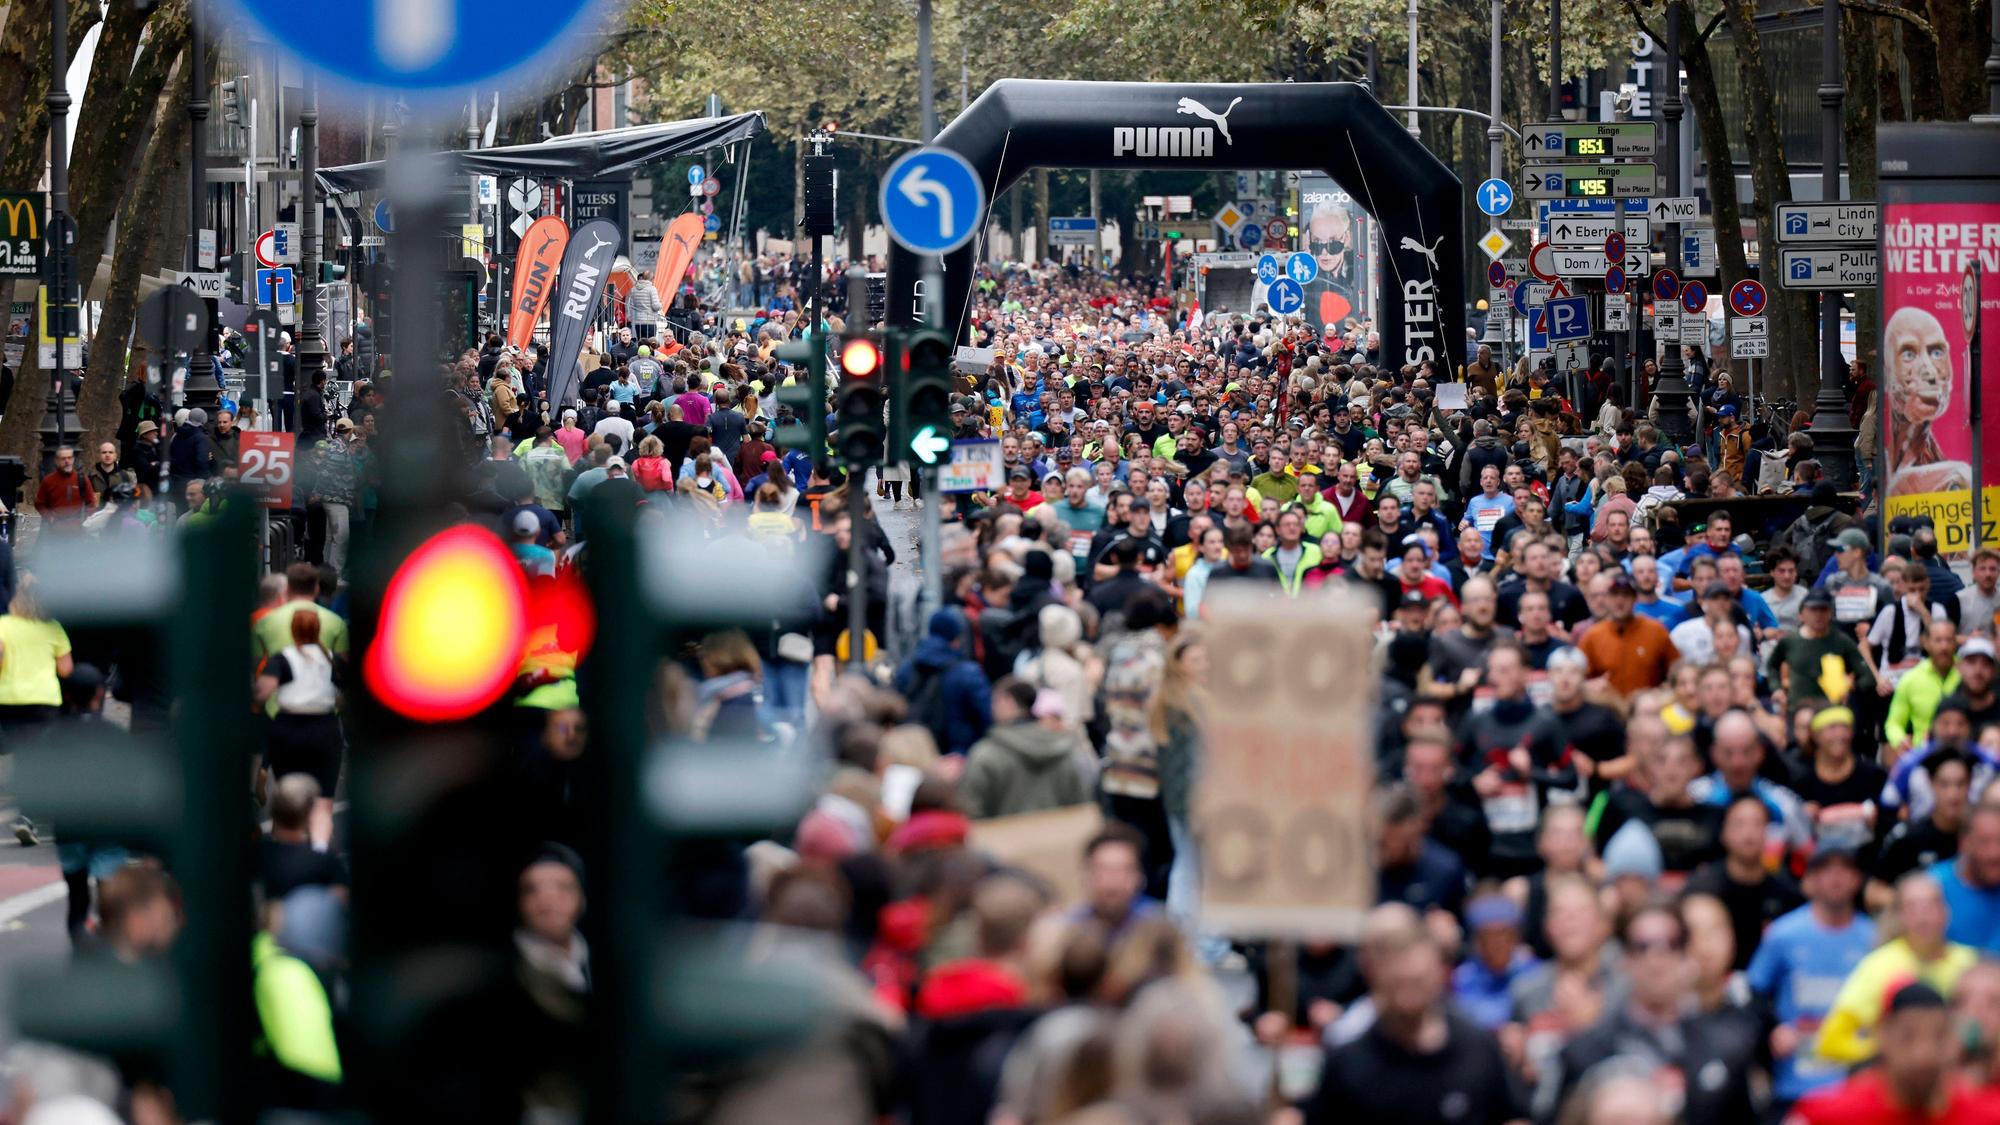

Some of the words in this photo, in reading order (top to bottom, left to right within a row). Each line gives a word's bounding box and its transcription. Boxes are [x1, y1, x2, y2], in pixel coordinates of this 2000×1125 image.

[1597, 126, 1620, 136] Ringe
[1113, 127, 1214, 157] PUMA
[1578, 139, 1605, 154] 851
[1597, 167, 1620, 177] Ringe
[1579, 179, 1606, 195] 495
[576, 193, 616, 205] WIESS
[1303, 191, 1350, 203] zalando
[577, 206, 601, 217] MIT
[1674, 203, 1694, 216] WC
[1271, 223, 1284, 235] 30
[1575, 224, 1638, 239] Ebertptz
[1838, 224, 1864, 239] City
[1884, 217, 2000, 248] KÖRPER
[19, 241, 30, 255] 3
[13, 255, 37, 266] MIN
[1505, 263, 1516, 271] WC
[1564, 257, 1590, 269] Dom
[1886, 249, 2000, 273] WELTEN
[200, 279, 220, 291] WC
[520, 260, 550, 316] RUN
[562, 262, 600, 321] RUN
[1935, 283, 1962, 297] Zyk
[1404, 279, 1435, 367] STER
[1553, 304, 1575, 335] P
[240, 448, 291, 486] 25
[1889, 495, 1992, 524] Verlänget
